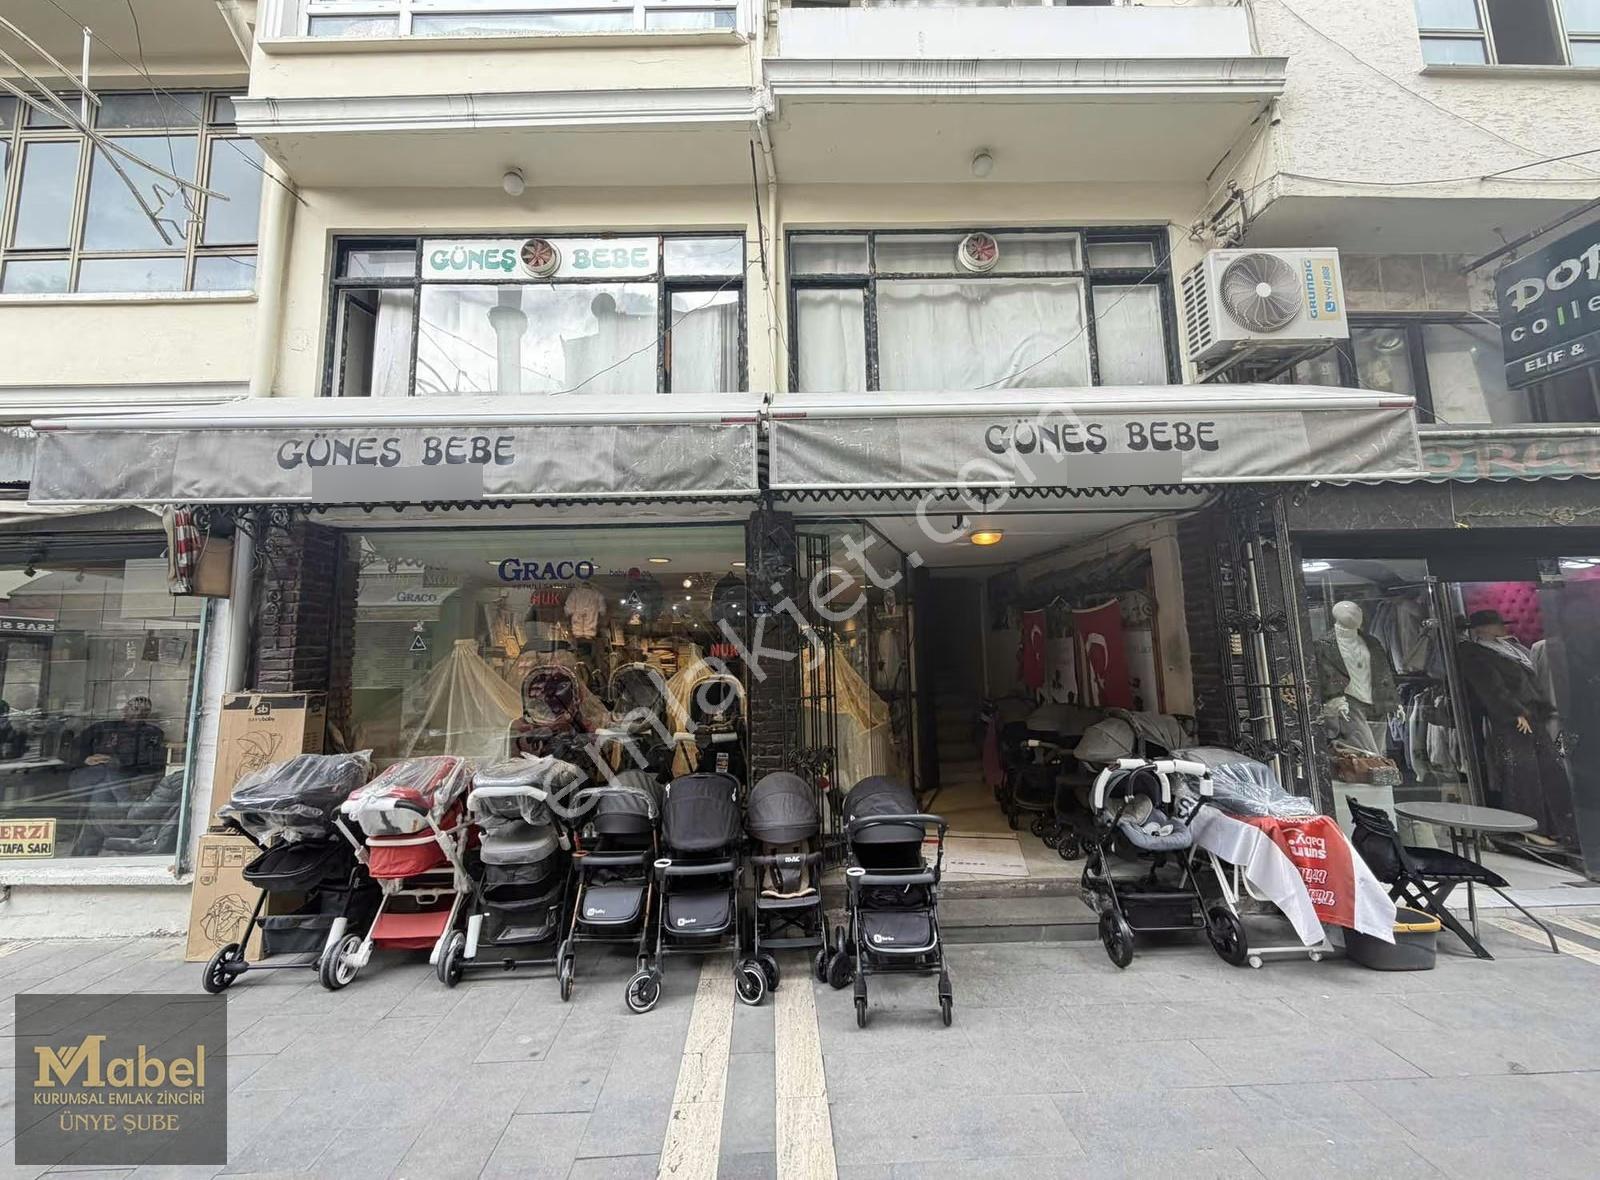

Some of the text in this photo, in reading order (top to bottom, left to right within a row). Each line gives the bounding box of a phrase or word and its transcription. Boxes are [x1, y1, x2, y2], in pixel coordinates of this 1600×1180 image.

[430, 246, 649, 272] GÜNEŞ BEBE
[1303, 260, 1318, 319] GRUNDIG
[1126, 422, 1219, 451] BEBE
[422, 436, 515, 466] BEBE
[498, 558, 594, 582] GRACO
[397, 591, 437, 602] GRACO
[0, 843, 24, 854] TAFA
